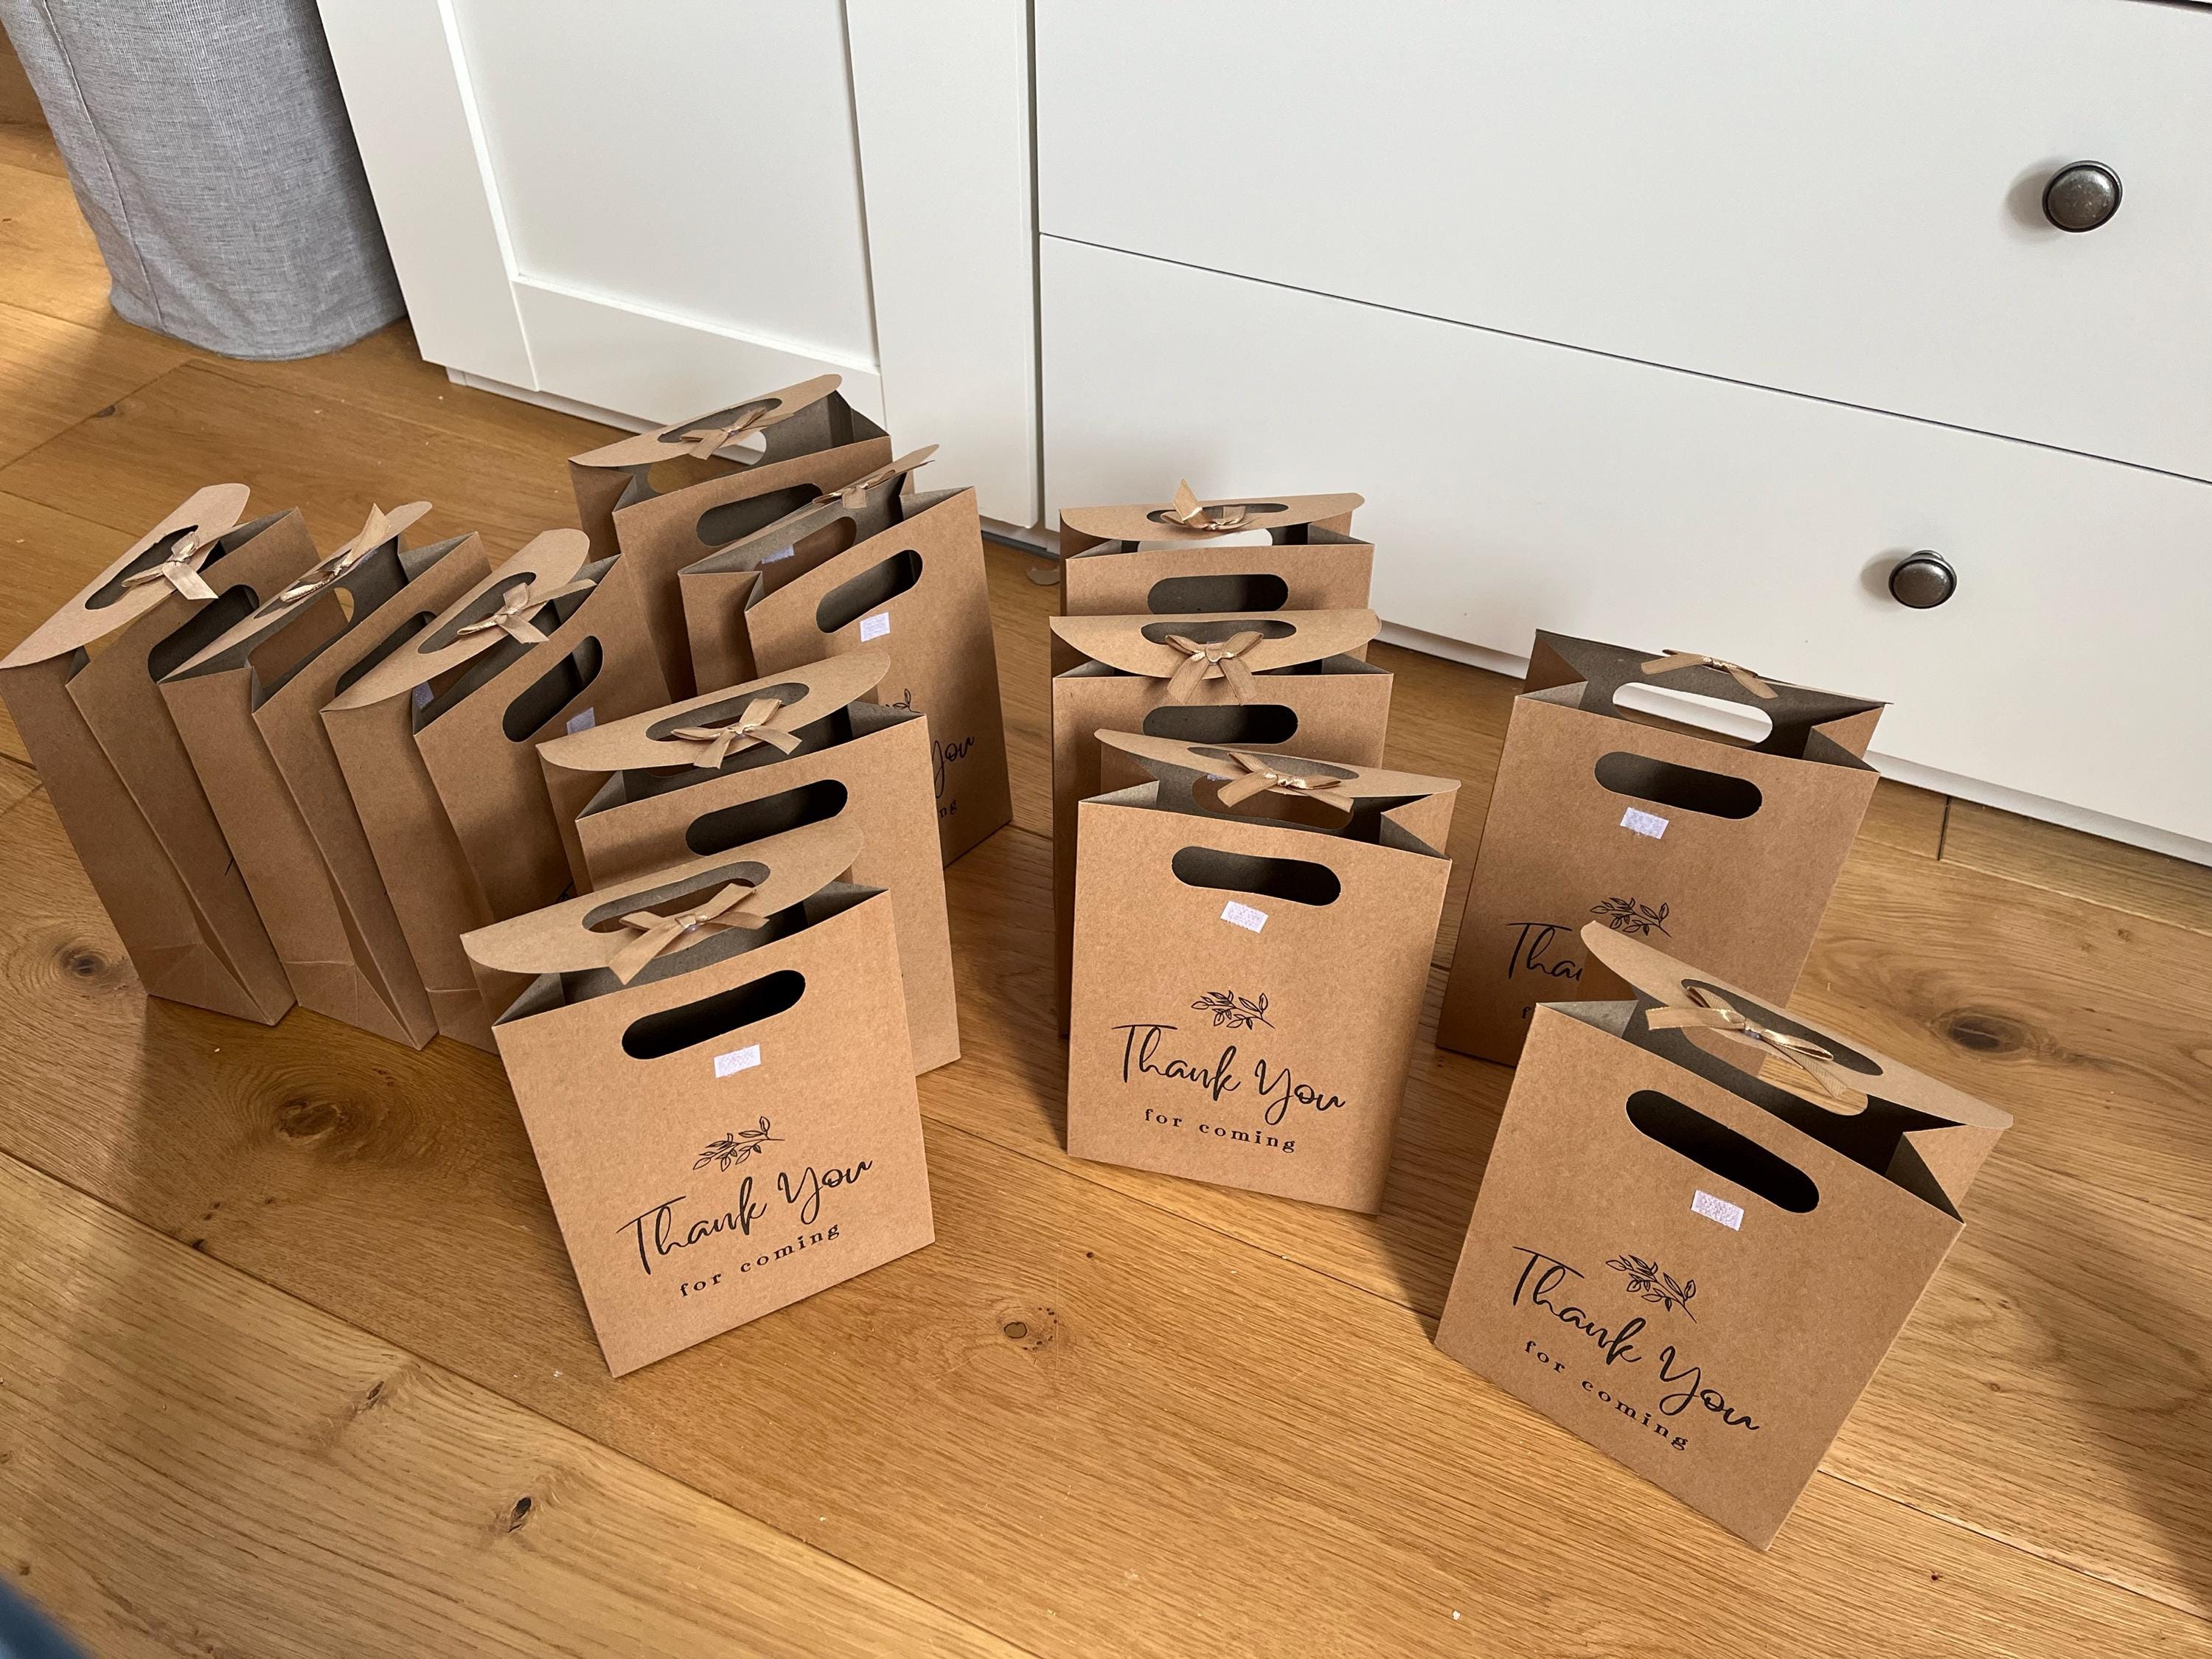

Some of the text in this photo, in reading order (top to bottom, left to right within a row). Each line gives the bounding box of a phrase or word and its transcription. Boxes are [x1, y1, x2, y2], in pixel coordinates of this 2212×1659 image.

[1506, 922, 1584, 981] Tha
[1111, 1023, 1346, 1125] Thank You
[1144, 1108, 1295, 1153] for coming
[616, 1161, 872, 1275] Thank You
[680, 1224, 840, 1297] for coming
[1512, 1246, 1759, 1430] Thank You
[1524, 1340, 1689, 1451] for coming
